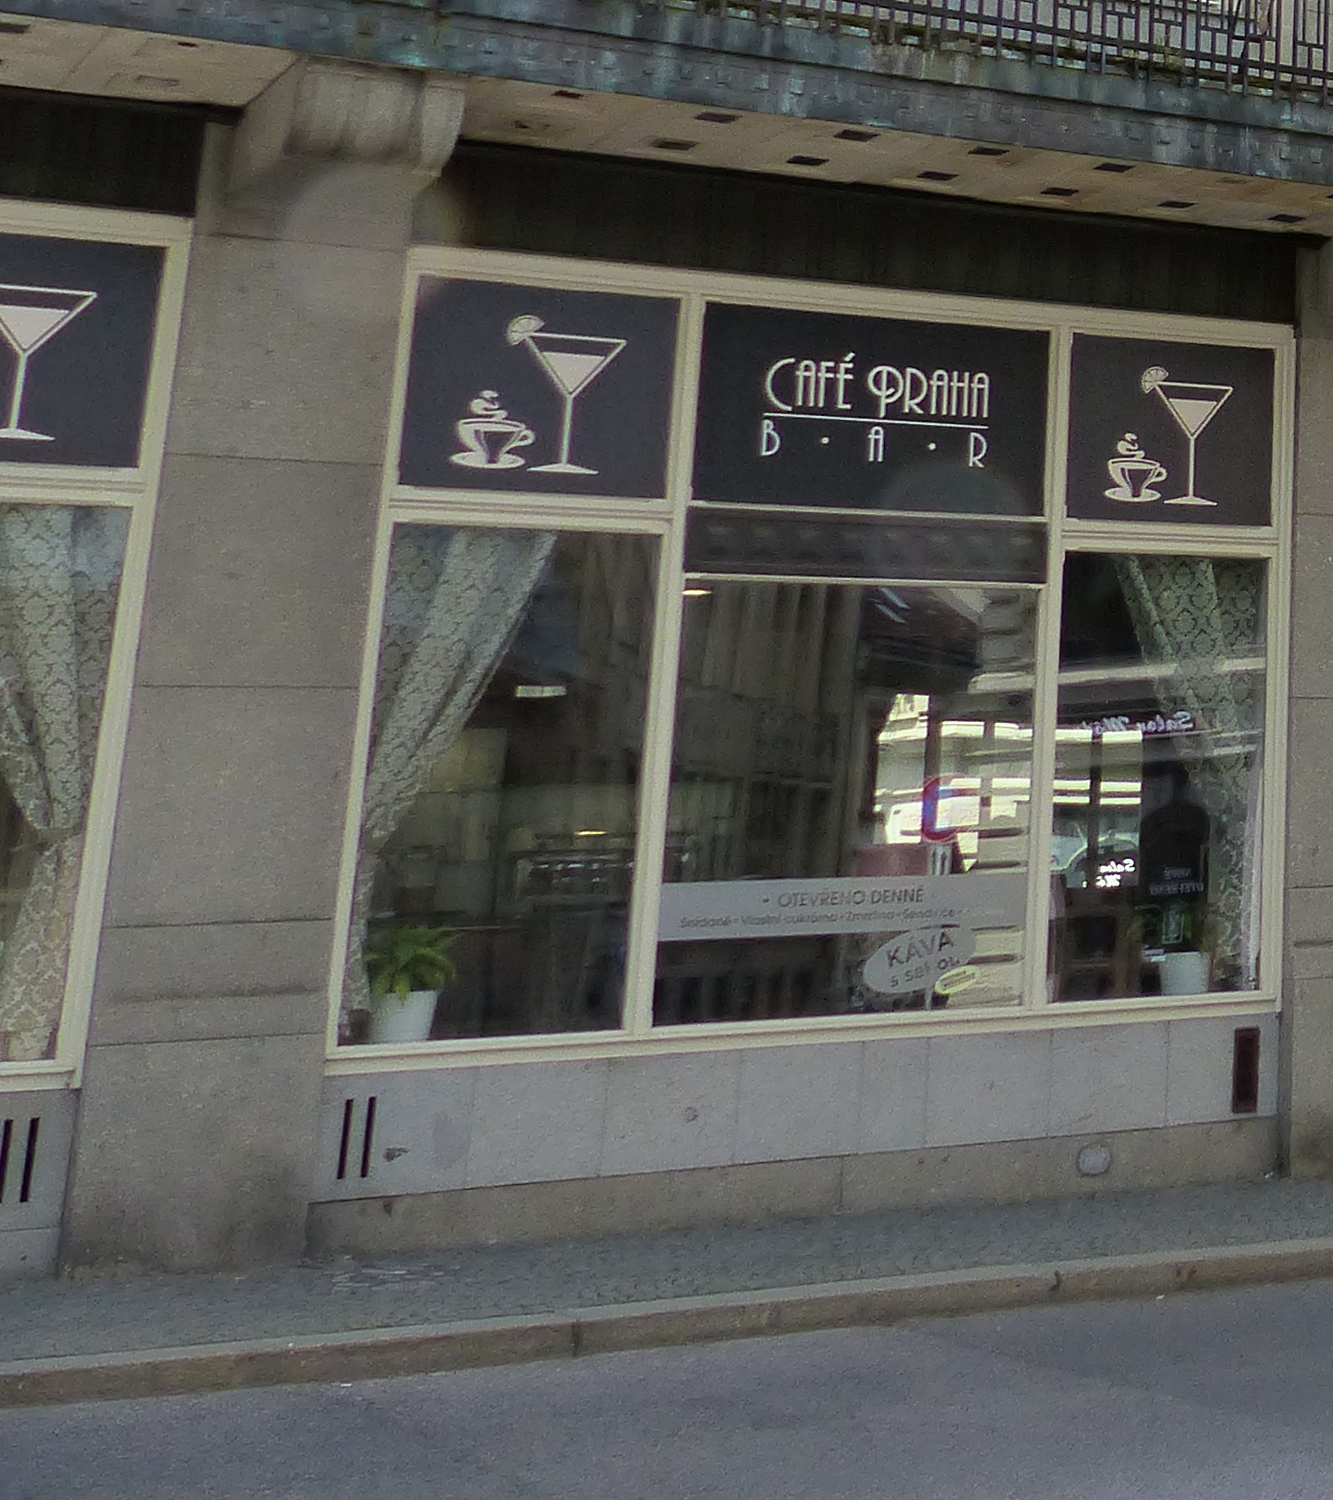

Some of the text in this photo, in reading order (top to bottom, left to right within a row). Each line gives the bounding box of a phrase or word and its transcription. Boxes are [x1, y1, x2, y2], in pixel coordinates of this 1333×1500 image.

[765, 352, 989, 417] CAFÉ PRAHA
[885, 931, 956, 968] KÁVA
